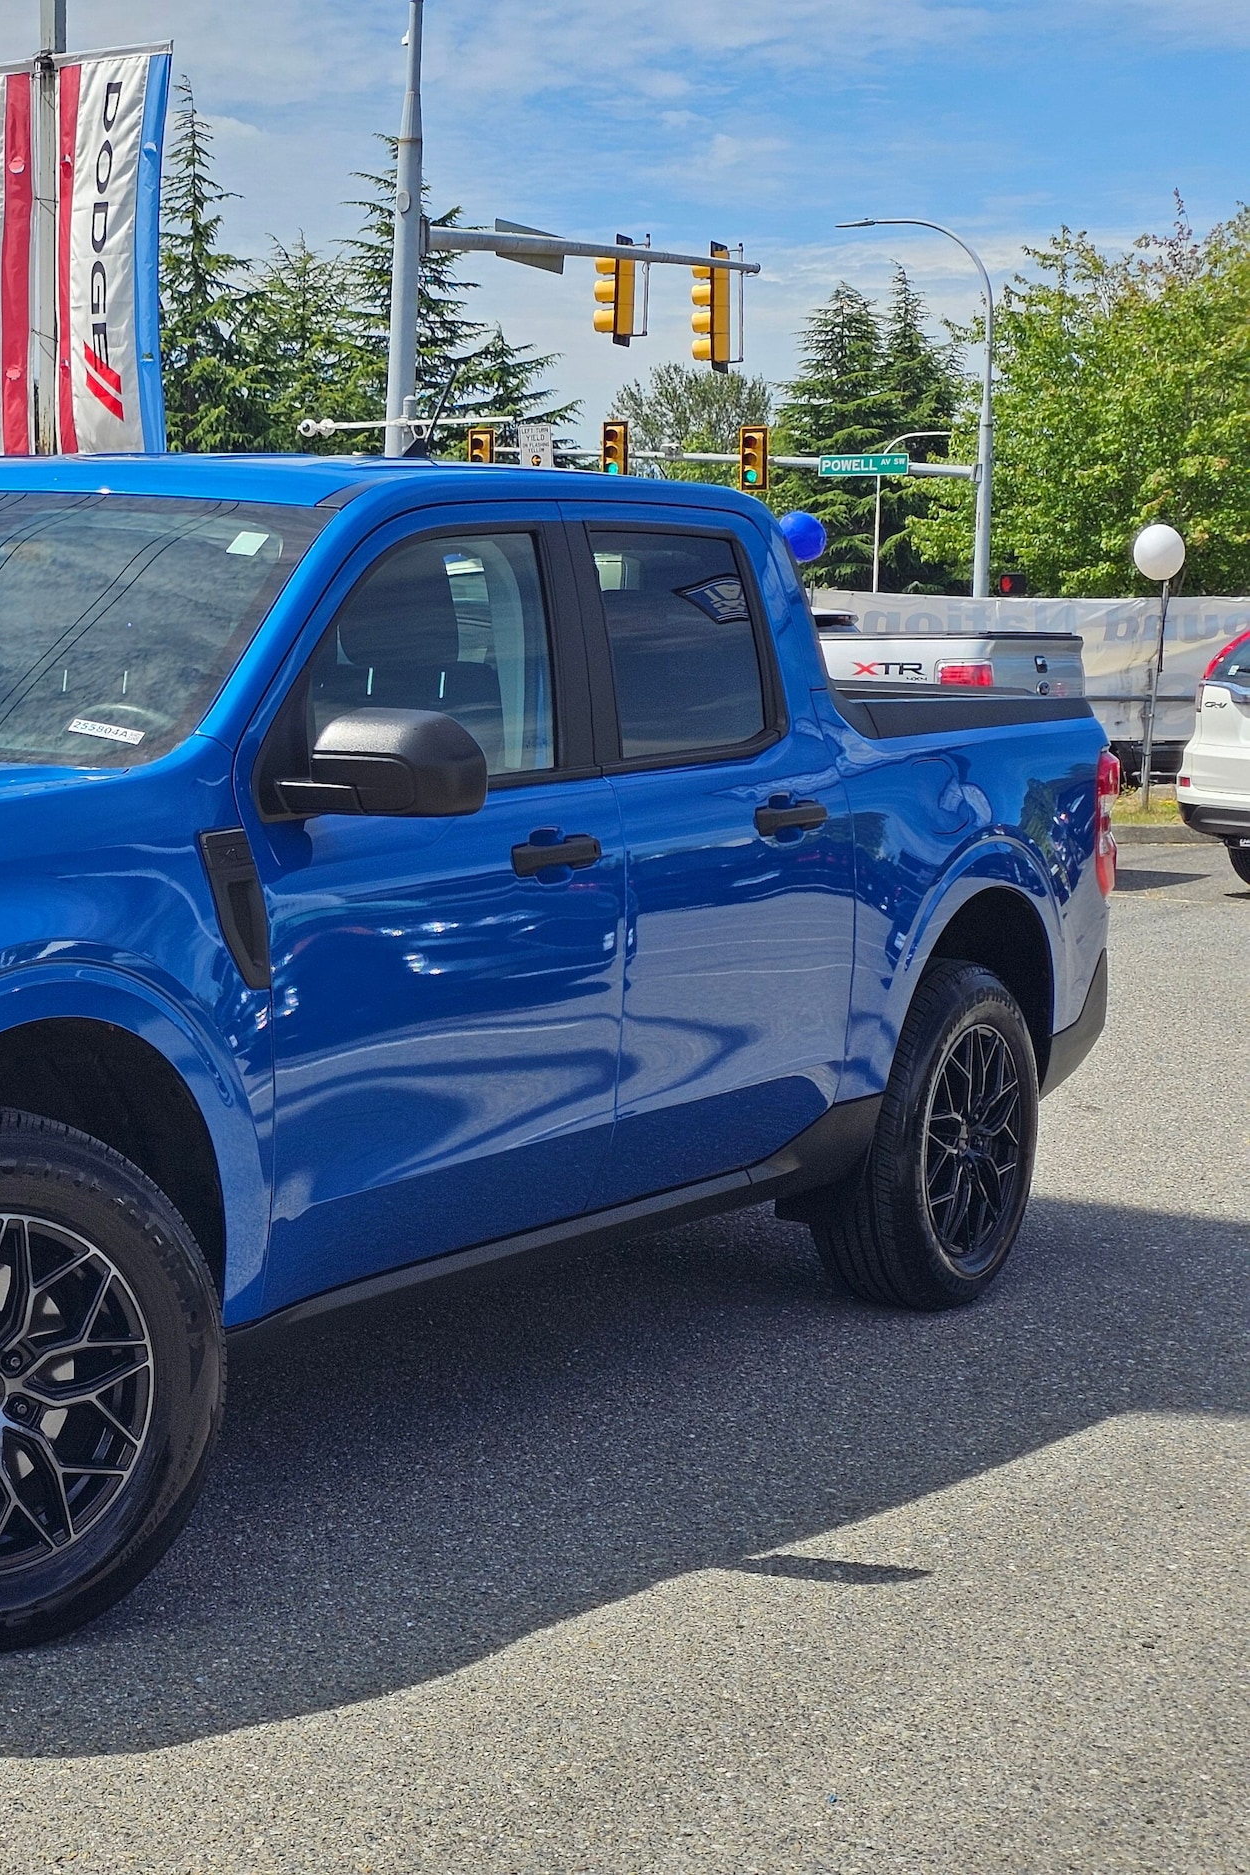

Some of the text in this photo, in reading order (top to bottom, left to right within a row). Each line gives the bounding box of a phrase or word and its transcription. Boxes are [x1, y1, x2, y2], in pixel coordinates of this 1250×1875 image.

[89, 81, 123, 371] DODGE
[821, 458, 878, 472] POWELL
[893, 457, 906, 465] SW
[852, 662, 925, 675] XTR
[73, 720, 128, 738] 255804A
